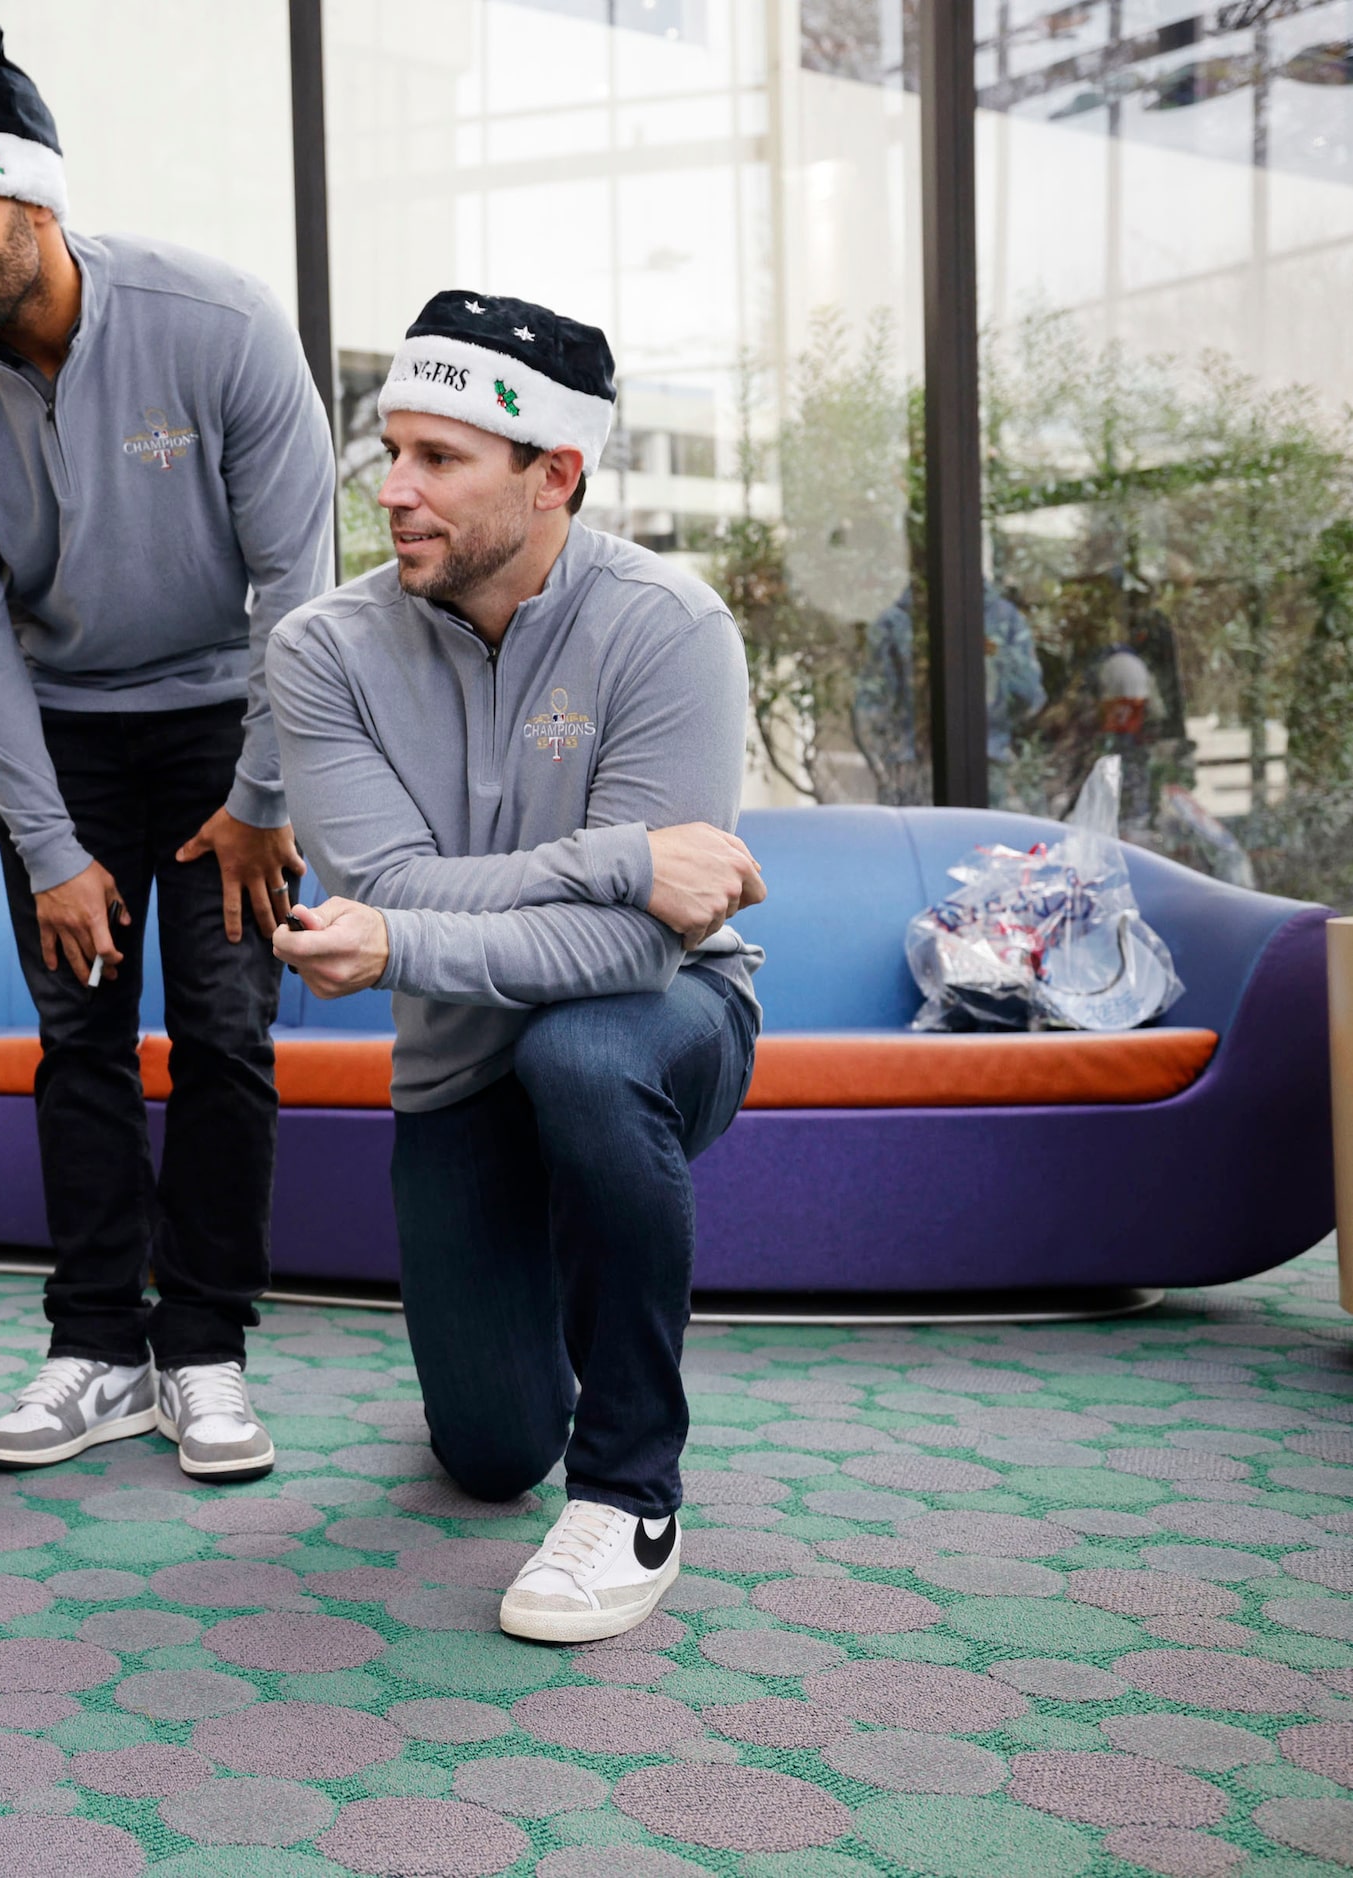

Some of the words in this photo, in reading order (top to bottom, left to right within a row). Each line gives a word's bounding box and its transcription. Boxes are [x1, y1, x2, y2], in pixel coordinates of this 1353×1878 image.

[412, 361, 470, 391] NGERS
[123, 432, 199, 454] CHAMPIONS
[523, 721, 596, 737] CHAMPIONS
